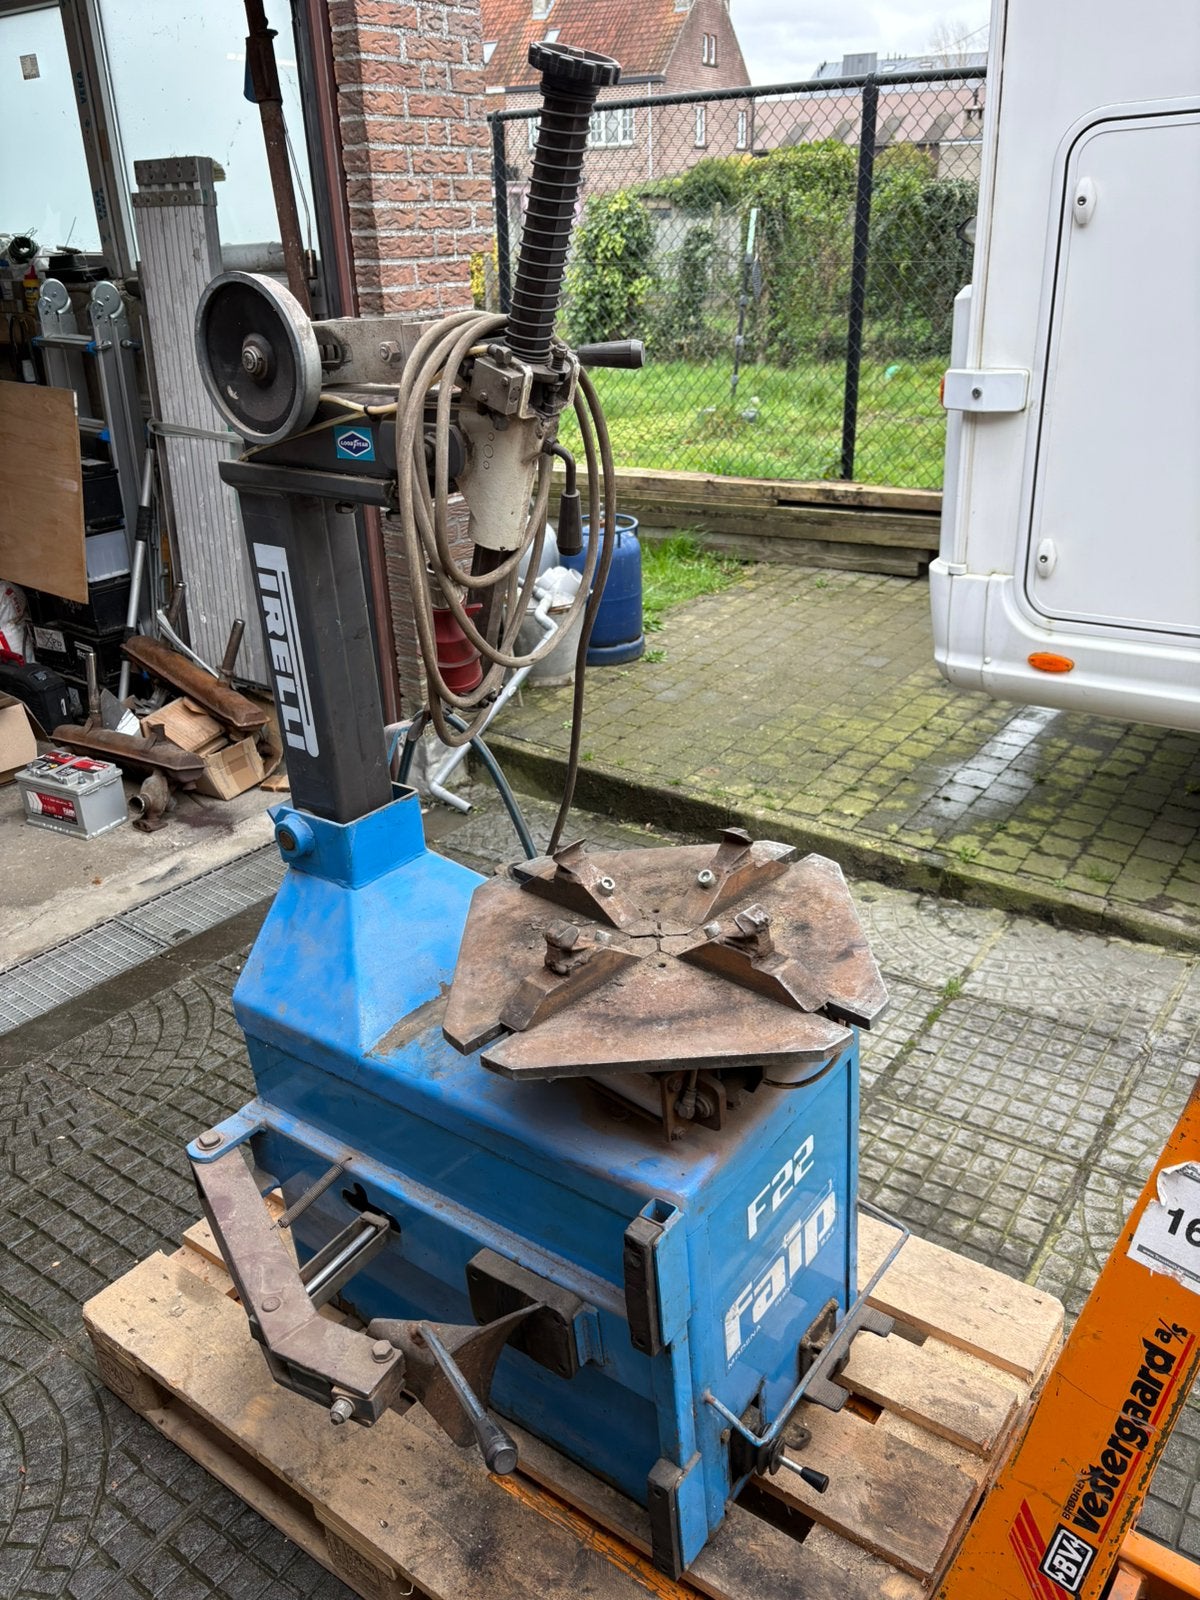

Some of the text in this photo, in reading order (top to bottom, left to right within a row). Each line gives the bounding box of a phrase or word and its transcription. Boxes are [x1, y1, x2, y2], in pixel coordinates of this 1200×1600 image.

[253, 542, 320, 758] PIRELLI
[747, 1134, 815, 1240] F22
[1052, 1539, 1084, 1579] BV
